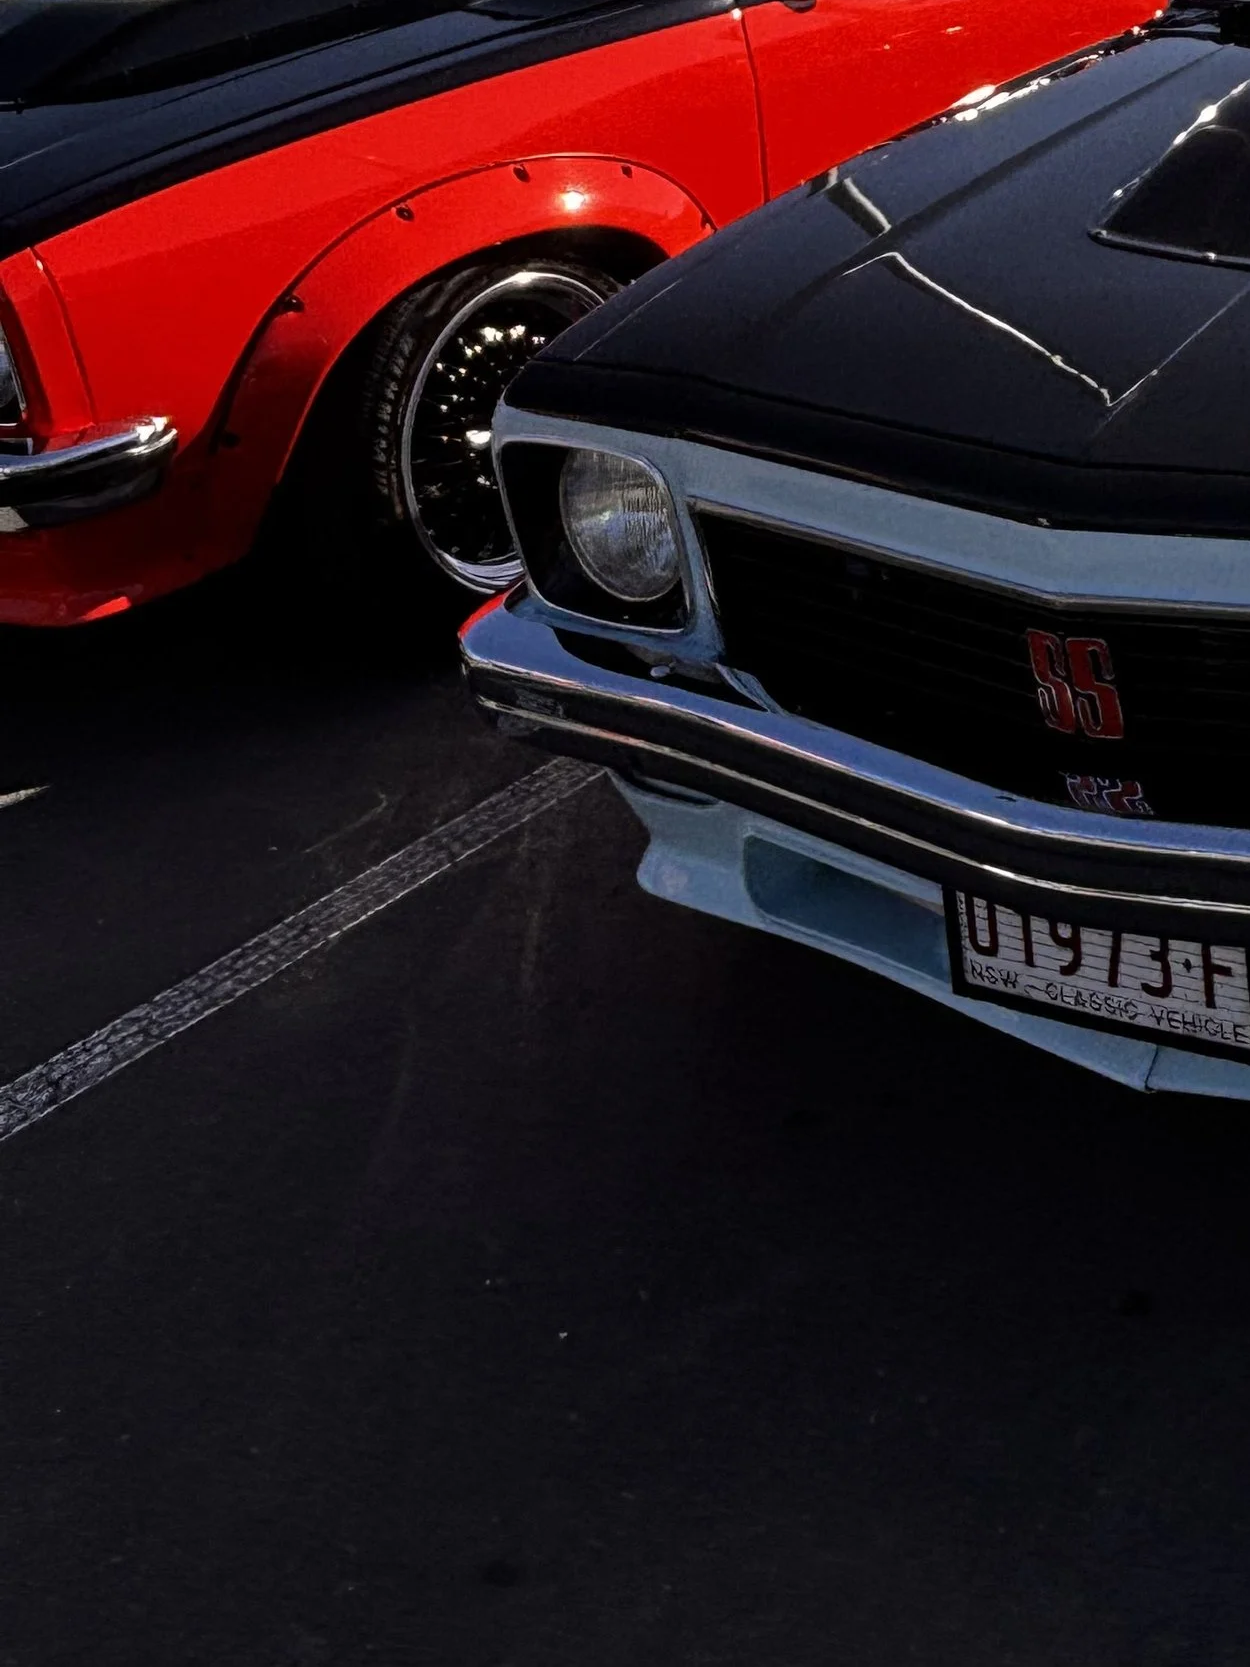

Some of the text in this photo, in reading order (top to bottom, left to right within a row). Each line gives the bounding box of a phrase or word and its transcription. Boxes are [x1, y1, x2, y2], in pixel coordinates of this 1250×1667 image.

[1025, 628, 1124, 739] SS
[968, 958, 1020, 990] NSW
[1044, 982, 1142, 1021] CLASSIC
